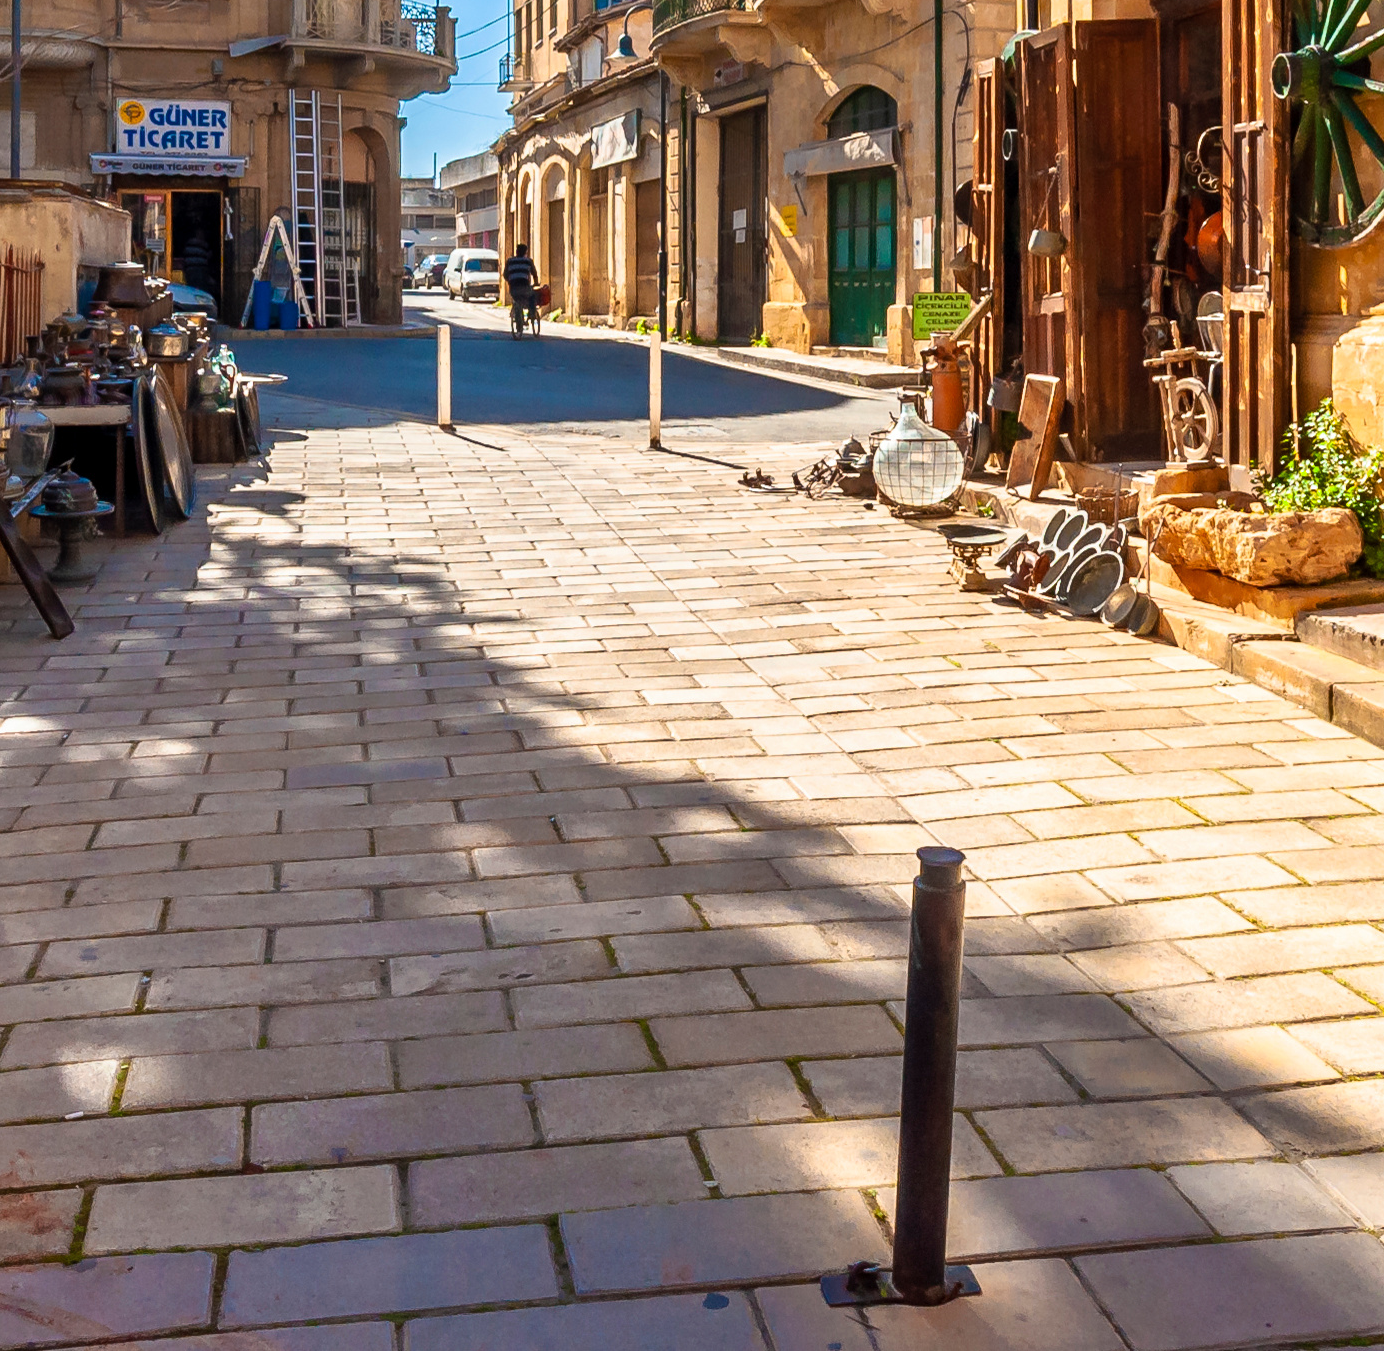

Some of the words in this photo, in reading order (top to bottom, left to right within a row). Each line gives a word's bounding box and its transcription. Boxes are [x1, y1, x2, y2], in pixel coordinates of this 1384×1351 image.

[148, 104, 228, 129] GÜNER
[122, 126, 225, 150] TİCARET
[132, 162, 165, 171] GÜNER
[167, 161, 206, 172] TİCARET
